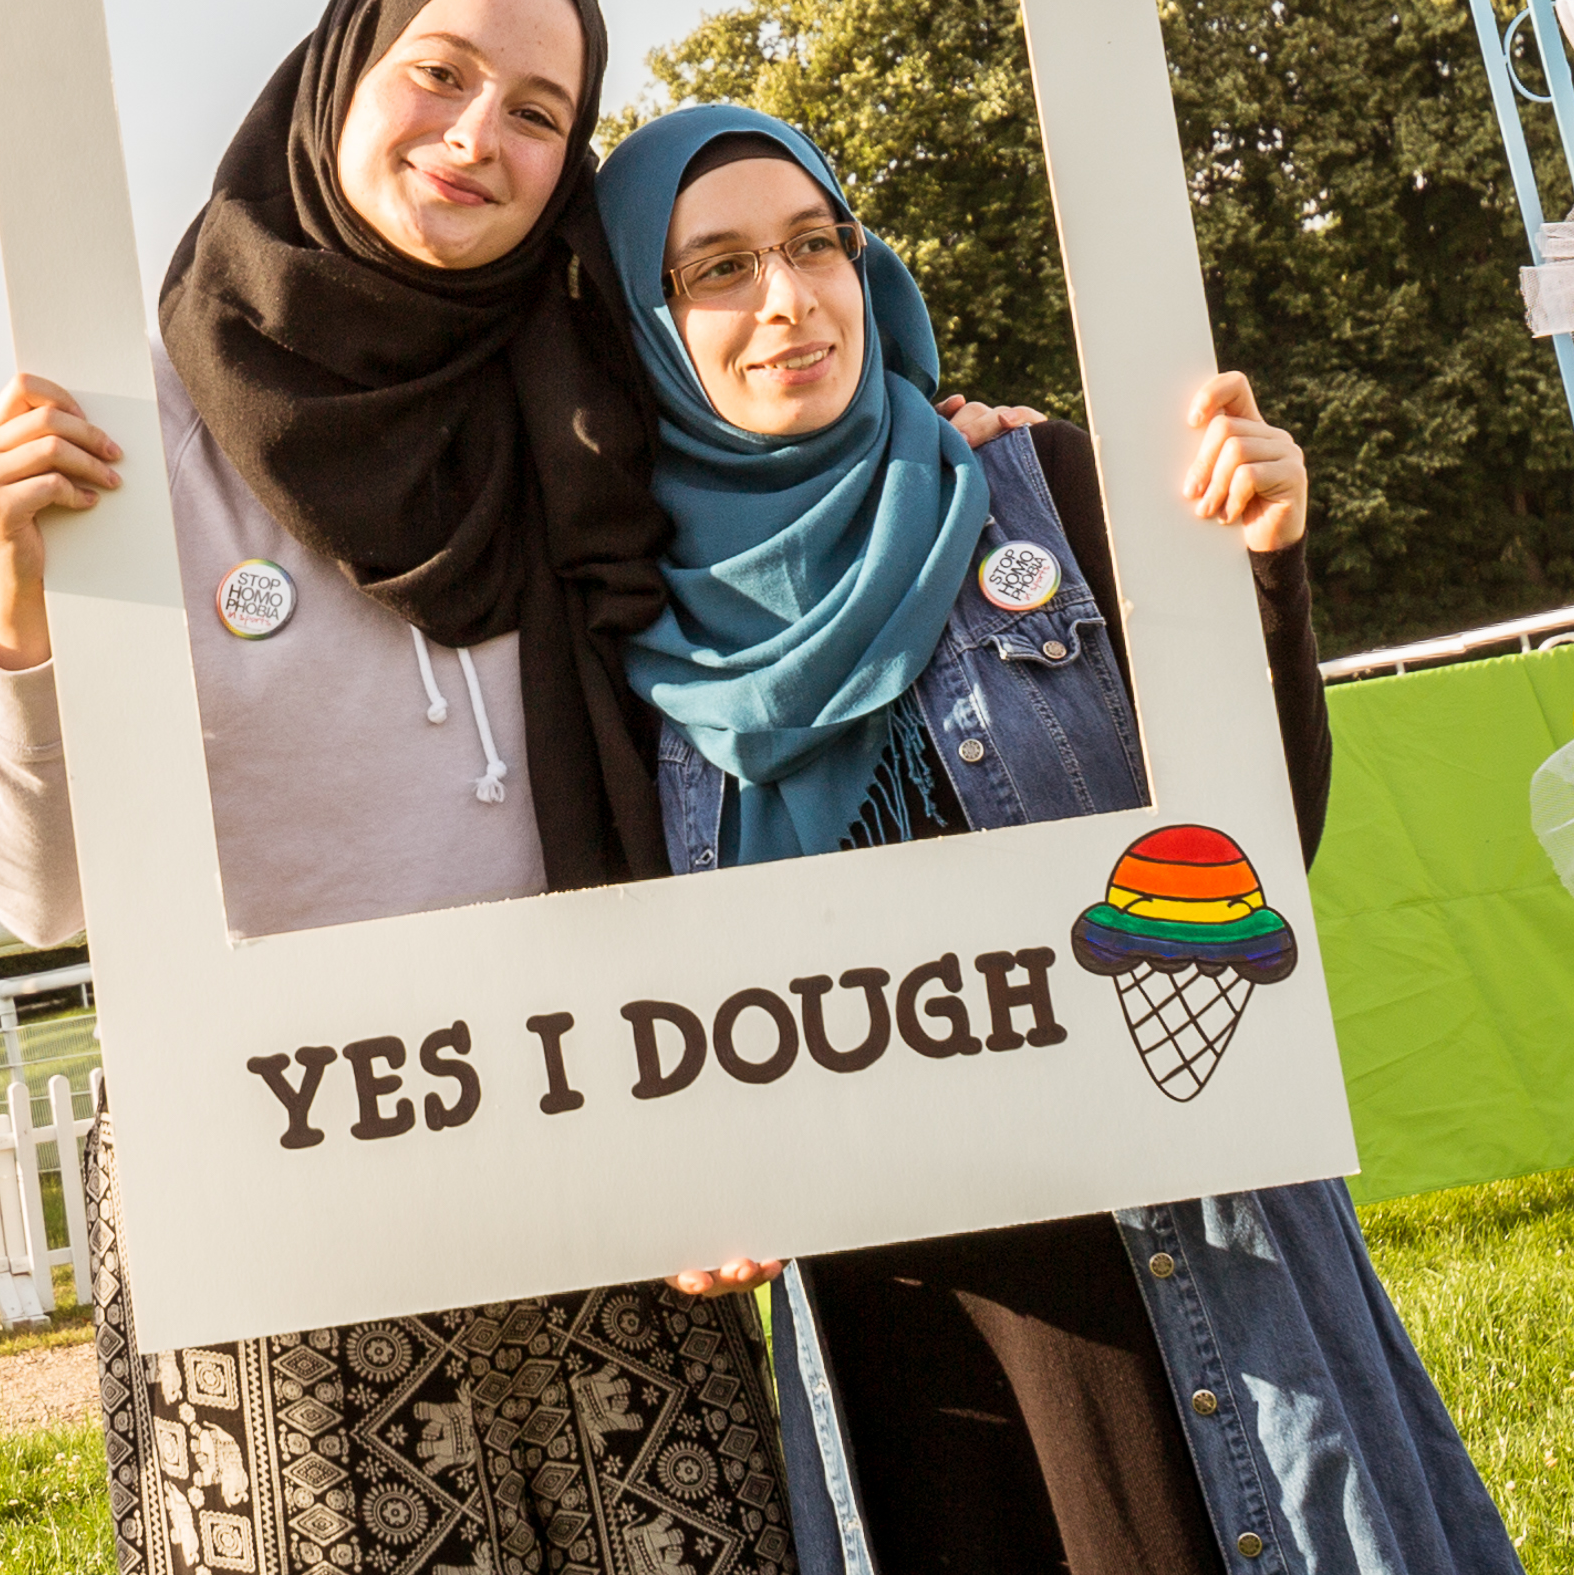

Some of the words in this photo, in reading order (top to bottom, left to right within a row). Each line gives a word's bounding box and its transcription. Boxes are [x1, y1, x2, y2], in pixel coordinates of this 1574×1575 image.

[237, 572, 281, 591] STOP
[989, 549, 1016, 585] STOP
[998, 550, 1034, 596] HOMO
[225, 598, 279, 621] PHOBIA
[228, 584, 283, 607] HOMO
[247, 1019, 482, 1150] YES
[526, 1011, 585, 1116] I
[622, 946, 1068, 1101] DOUGH
